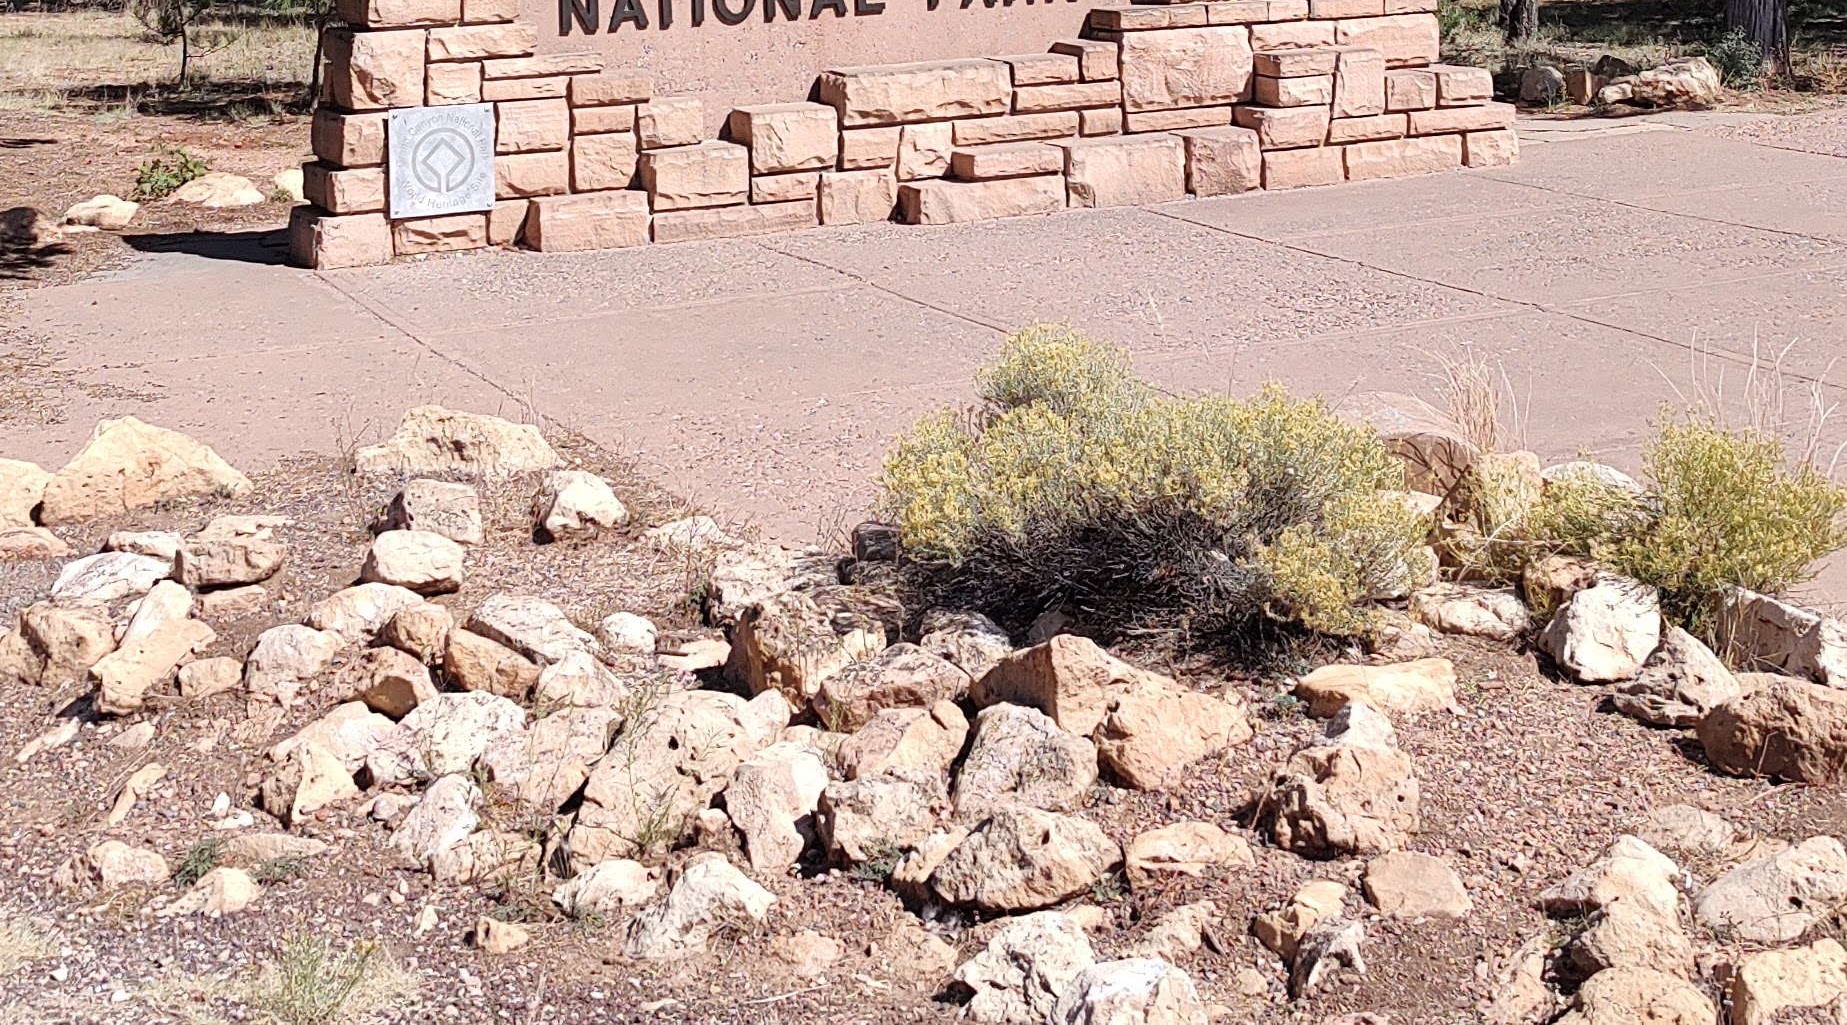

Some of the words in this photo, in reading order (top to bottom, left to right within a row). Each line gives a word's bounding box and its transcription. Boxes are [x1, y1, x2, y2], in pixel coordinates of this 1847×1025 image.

[408, 113, 445, 136] Canyon
[446, 113, 482, 139] National
[401, 179, 425, 204] World
